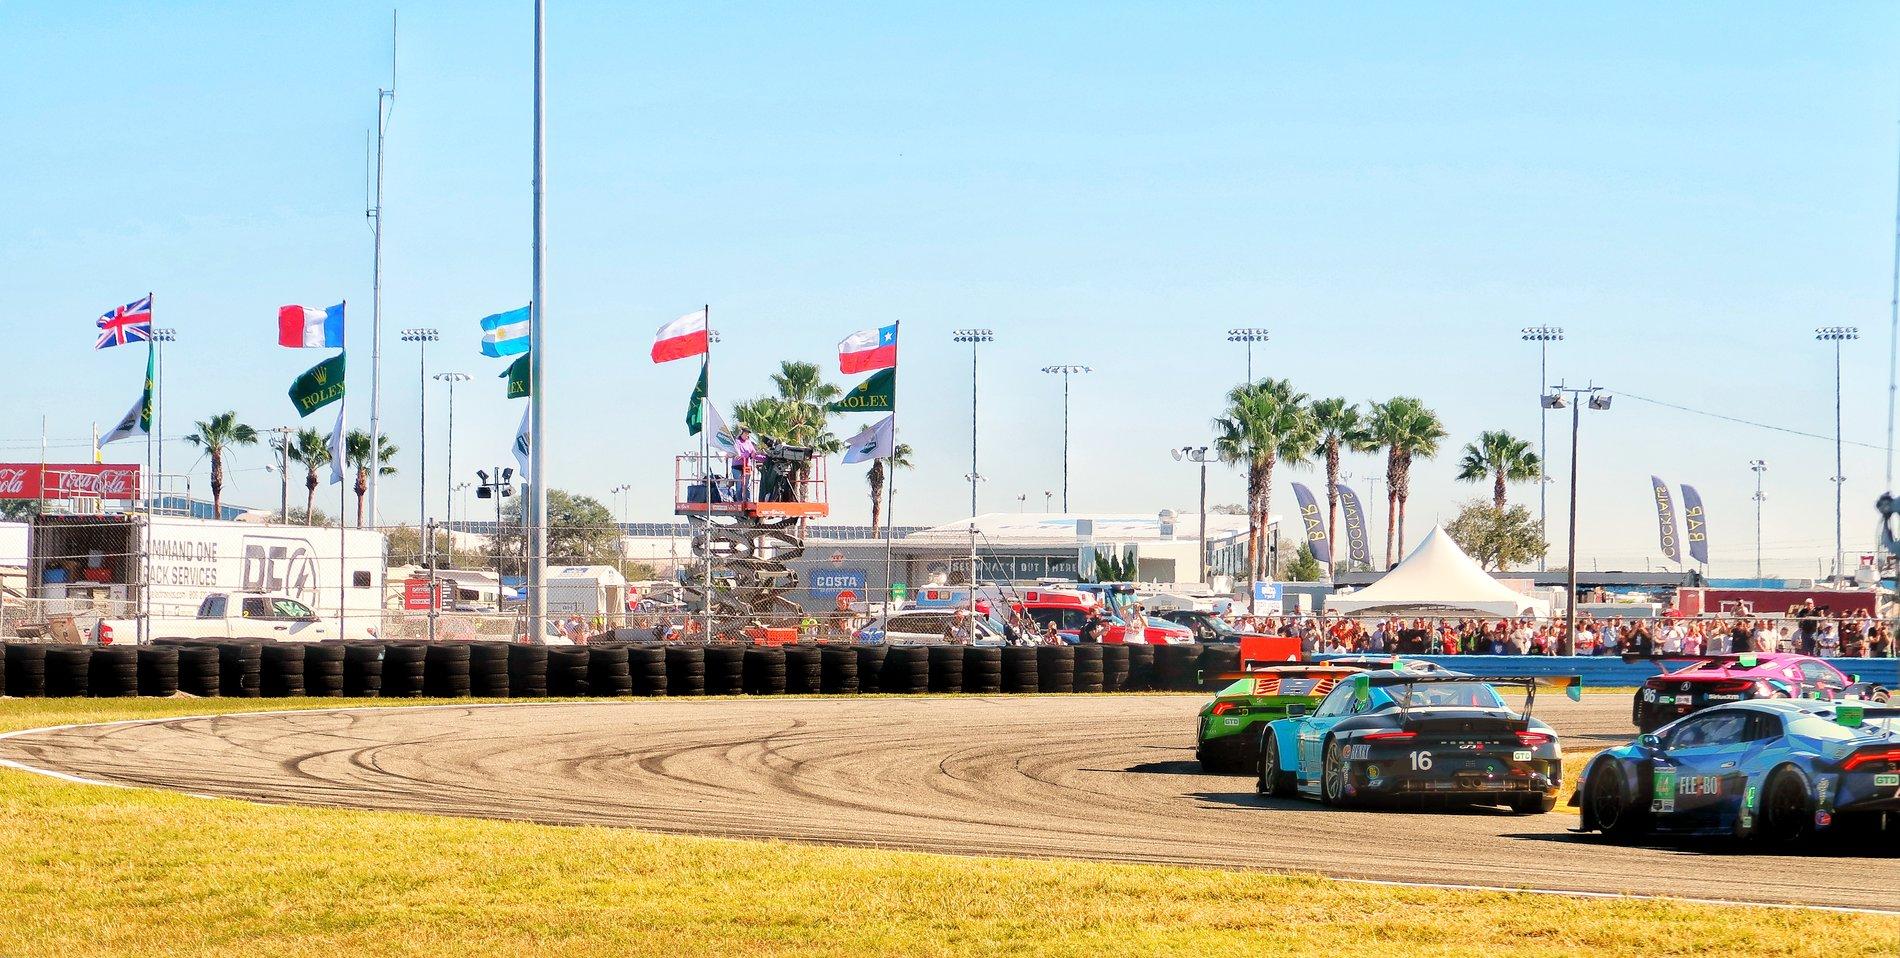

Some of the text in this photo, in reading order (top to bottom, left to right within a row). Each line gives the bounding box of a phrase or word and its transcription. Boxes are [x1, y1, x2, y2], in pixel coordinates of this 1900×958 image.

[301, 382, 344, 409] ROLEX
[196, 541, 217, 562] ONE
[143, 565, 217, 586] RACK SERVICES
[1021, 563, 1040, 572] OUT
[817, 576, 857, 587] COSTA
[1409, 750, 1433, 771] 16
[1514, 752, 1531, 760] GTD
[1875, 776, 1898, 785] GTD
